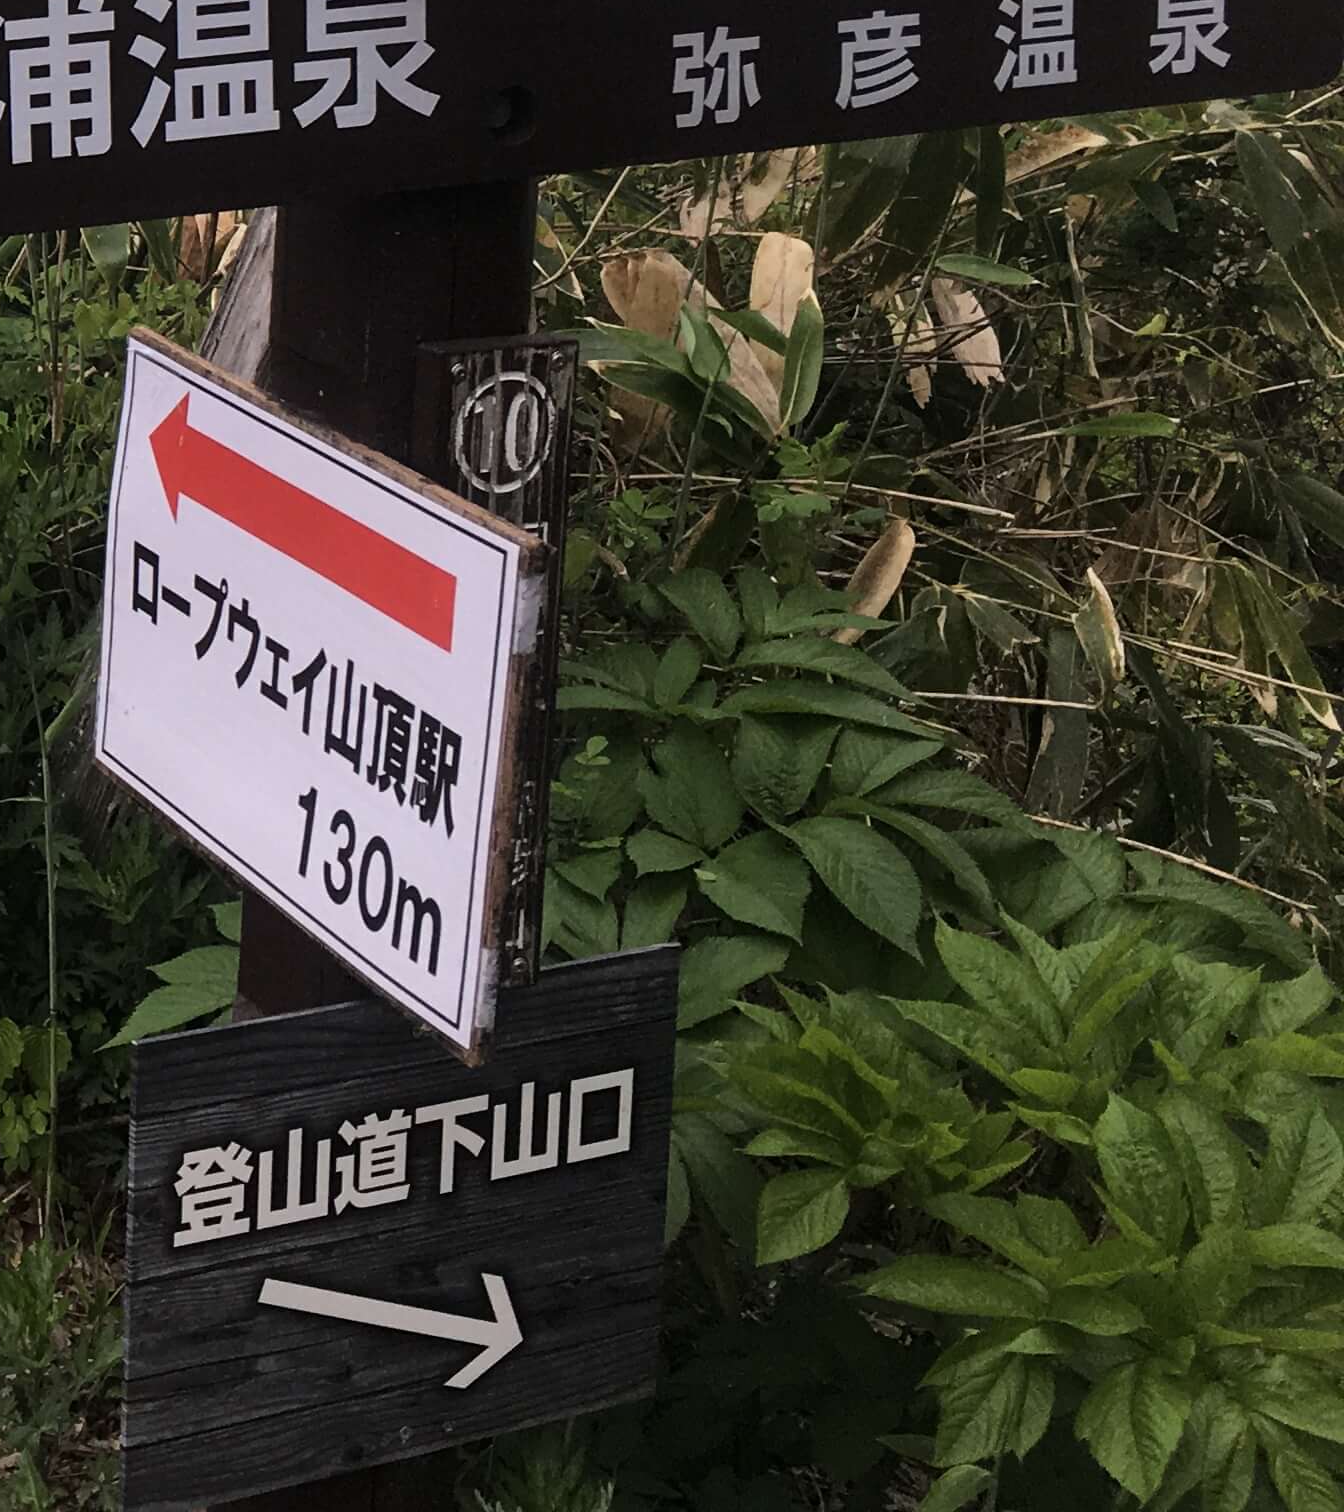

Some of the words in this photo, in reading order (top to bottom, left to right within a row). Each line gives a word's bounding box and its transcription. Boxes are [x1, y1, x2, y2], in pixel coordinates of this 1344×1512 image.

[131, 539, 463, 840] ロープウェイ山頂駅
[297, 785, 443, 976] 130m
[172, 1067, 635, 1248] 登山道下山口
